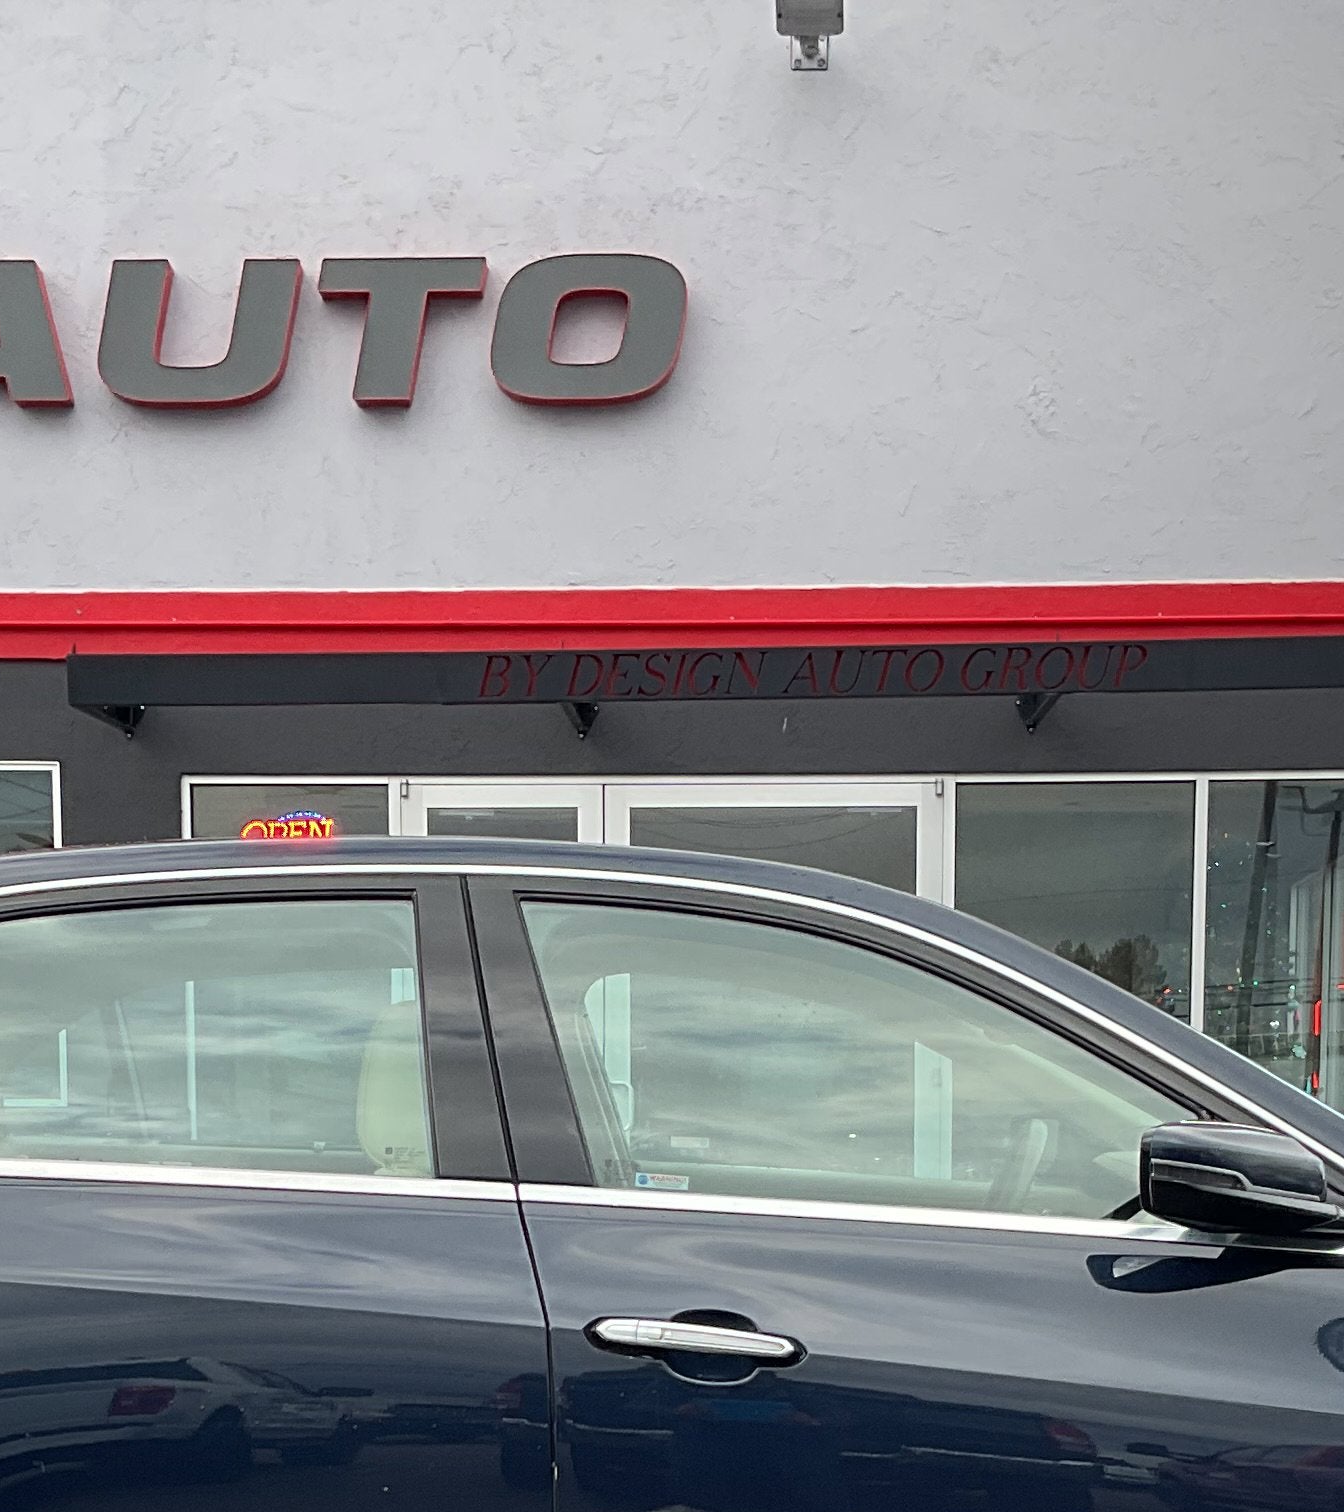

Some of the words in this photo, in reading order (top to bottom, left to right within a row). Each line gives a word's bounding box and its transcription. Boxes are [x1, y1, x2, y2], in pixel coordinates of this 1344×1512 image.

[477, 652, 554, 698] BY
[566, 650, 769, 697] DESIGN
[781, 647, 946, 695] AUTO
[959, 643, 1149, 692] GROUP
[239, 817, 336, 839] OPEN
